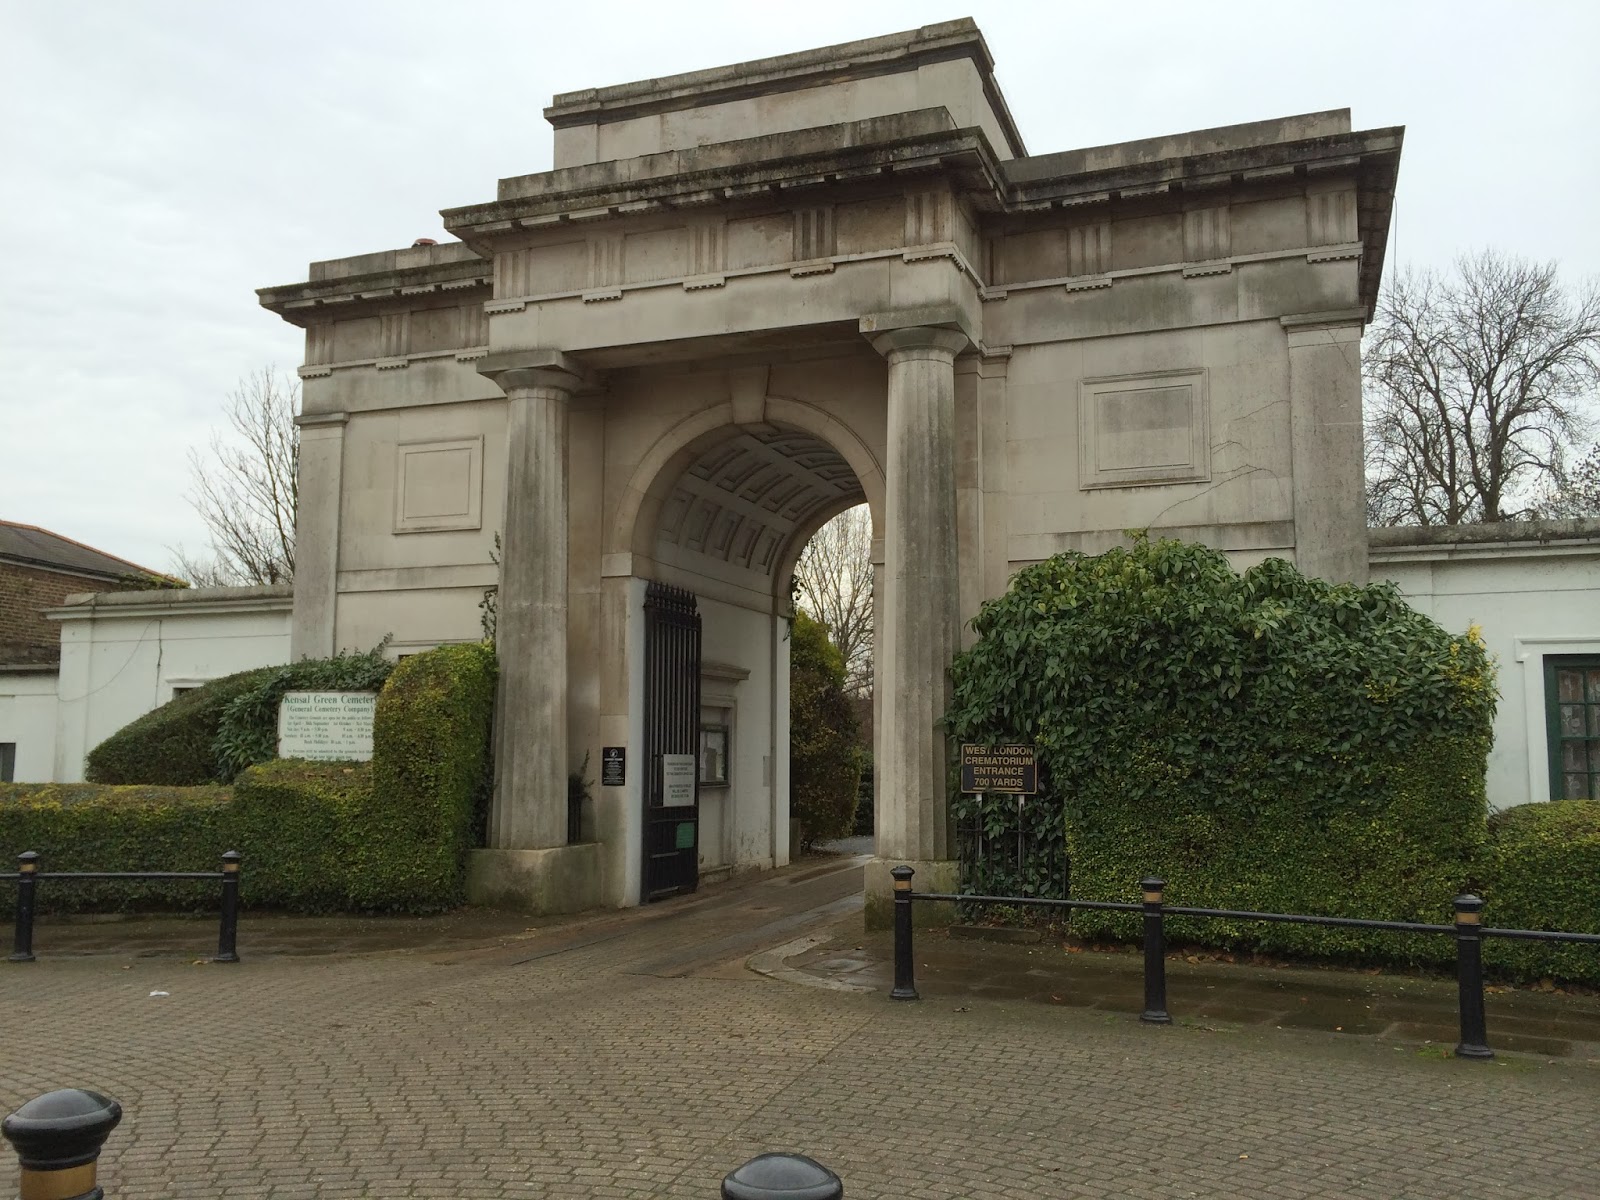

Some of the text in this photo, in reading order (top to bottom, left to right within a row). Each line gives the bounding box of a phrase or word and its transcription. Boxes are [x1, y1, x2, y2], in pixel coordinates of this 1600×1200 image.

[284, 694, 376, 704] Kensal Green Cemeter
[314, 706, 340, 714] Cemetery
[344, 706, 374, 714] Company)
[994, 746, 1033, 755] LONDON
[965, 756, 1033, 765] CREMATORIUM
[974, 766, 1024, 775] ENTRANCE
[974, 778, 1024, 786] 700 YARDS
